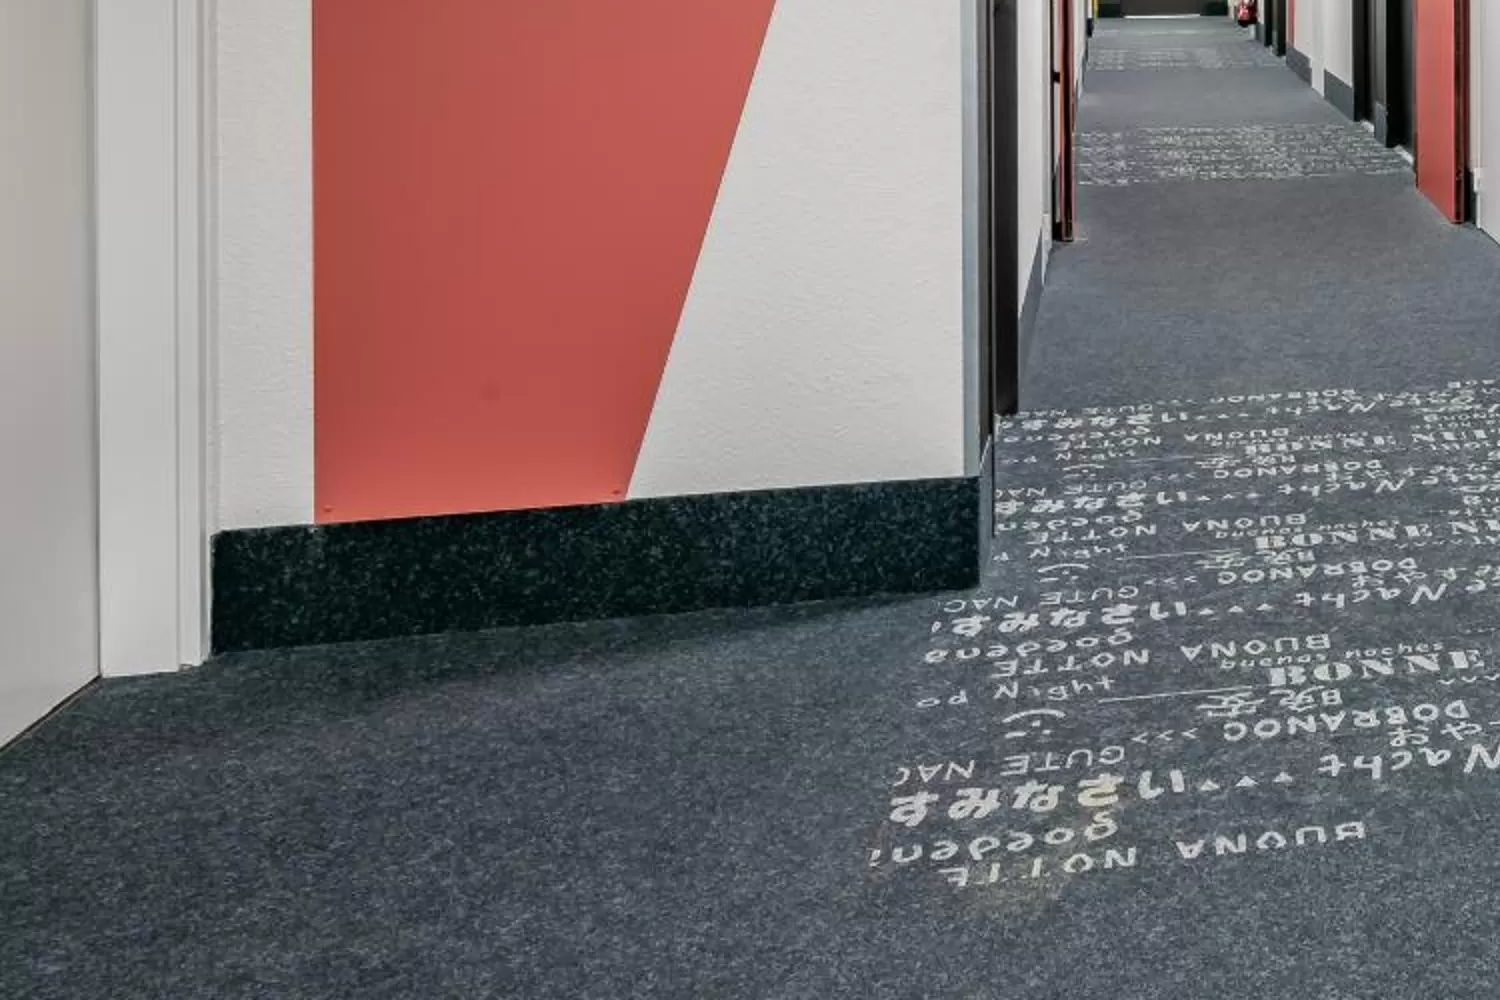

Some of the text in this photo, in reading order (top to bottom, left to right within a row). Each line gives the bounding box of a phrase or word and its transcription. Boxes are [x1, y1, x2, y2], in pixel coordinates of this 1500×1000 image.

[1180, 633, 1331, 661] BUONA
[1222, 699, 1471, 742] DOBRANOC
[999, 745, 1126, 777] GUTE
[1174, 820, 1367, 860] BUONA
